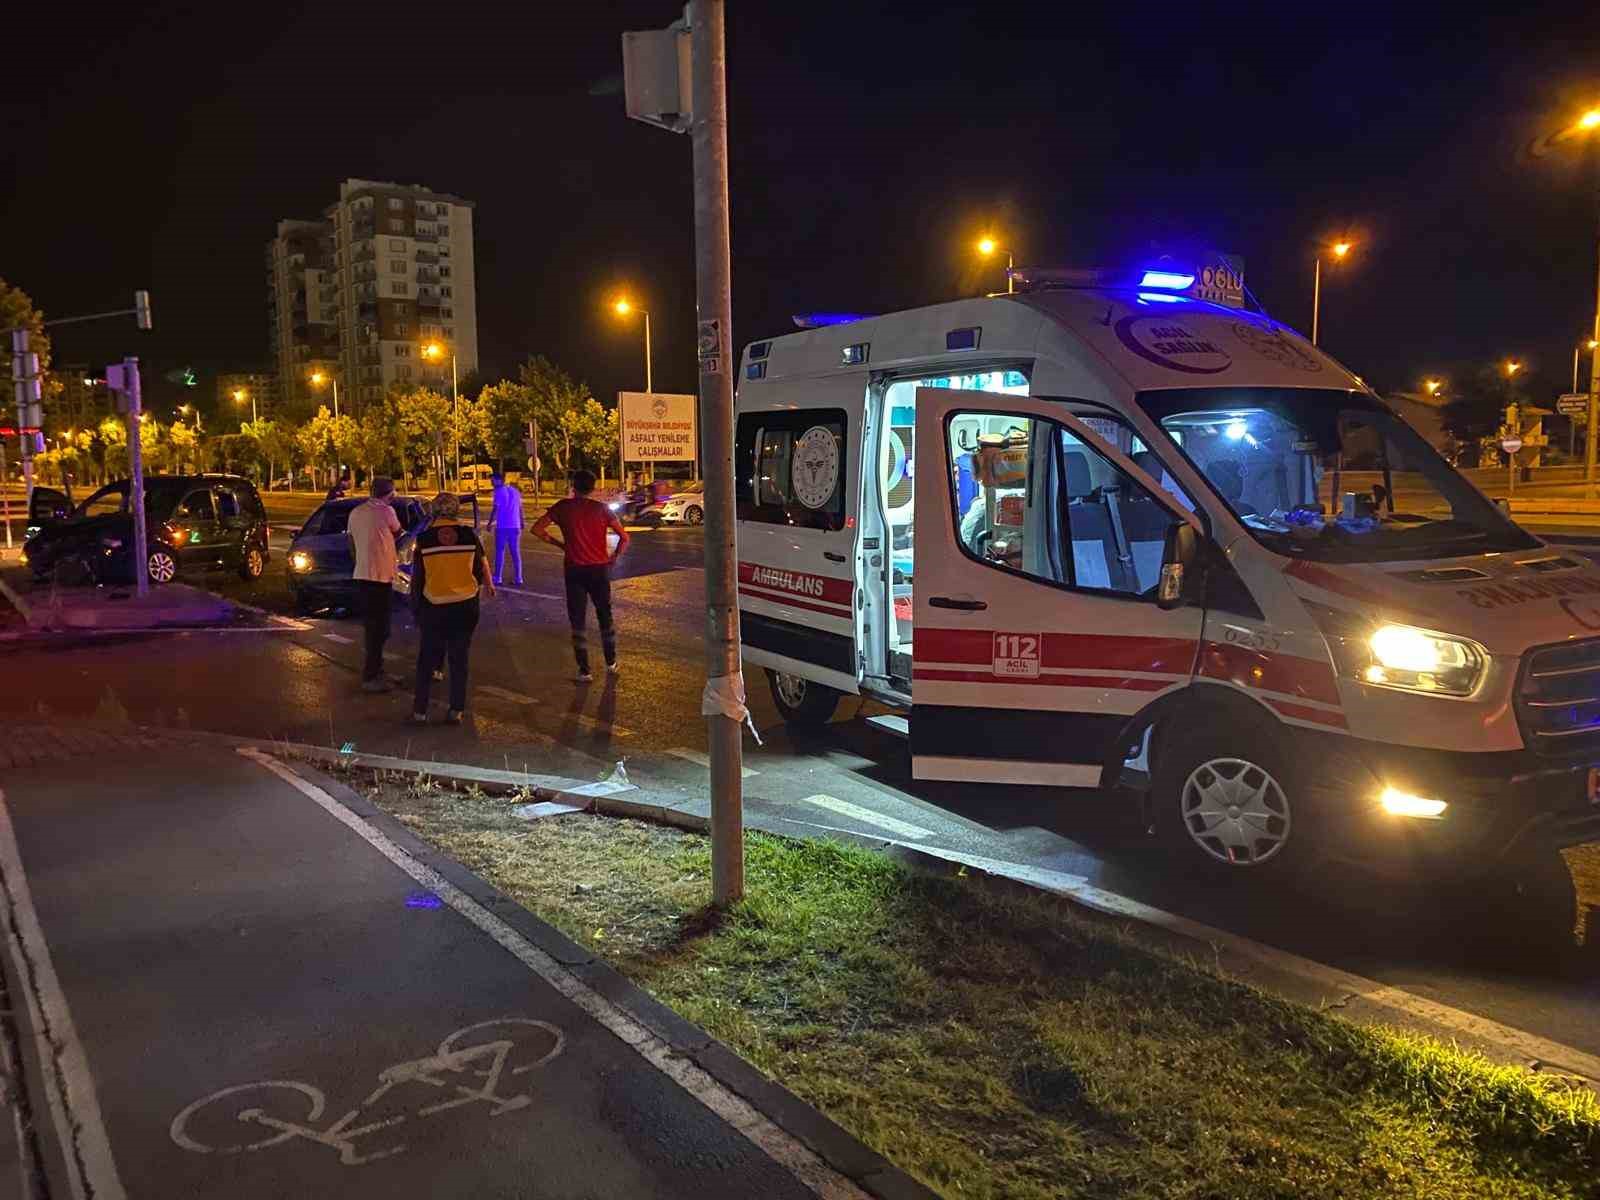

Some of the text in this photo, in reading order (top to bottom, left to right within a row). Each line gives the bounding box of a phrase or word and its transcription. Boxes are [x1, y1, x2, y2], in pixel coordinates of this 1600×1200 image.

[630, 433, 656, 443] ASFALT
[638, 446, 683, 457] ÇALIŞMALARI
[752, 566, 824, 596] AMBULANS
[996, 635, 1037, 658] 112
